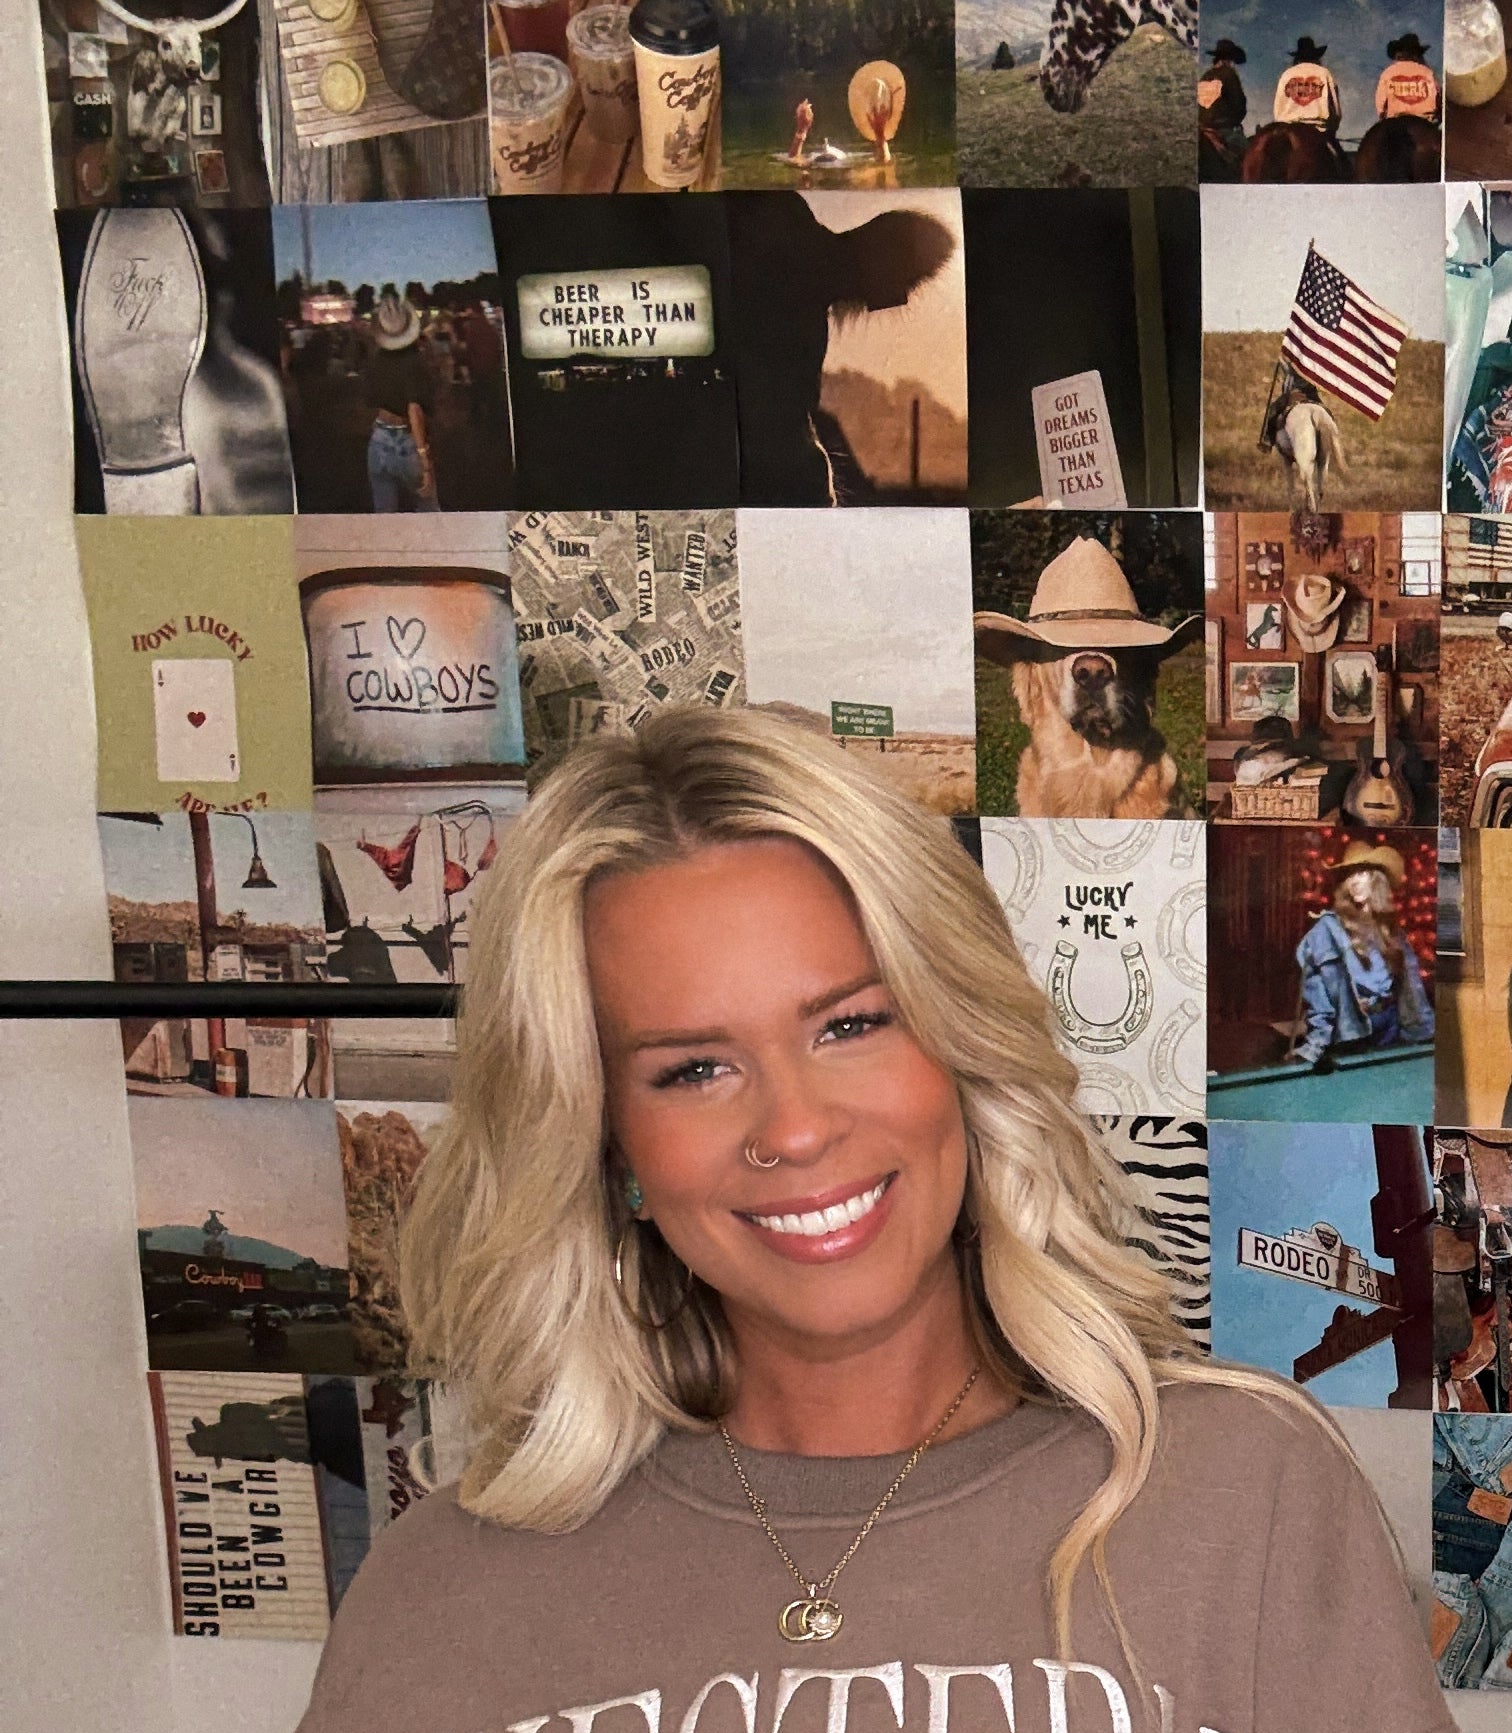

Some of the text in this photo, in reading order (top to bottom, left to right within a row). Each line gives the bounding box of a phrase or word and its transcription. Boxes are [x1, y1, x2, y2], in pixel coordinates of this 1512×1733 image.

[73, 91, 113, 106] CASH
[554, 281, 651, 304] BEER IS
[539, 302, 696, 327] CHEAPER THAN
[567, 327, 658, 348] THERAPY
[1054, 392, 1079, 412] GOT
[1044, 407, 1099, 435] DREAMS
[1049, 428, 1099, 454] BIGGER
[1058, 450, 1096, 473] THAN
[1058, 470, 1104, 496] TEXAS
[635, 511, 653, 619] WILD WEST
[683, 531, 706, 593] WANTED
[131, 615, 255, 662] HOW LUCKY
[341, 621, 373, 658] I
[640, 637, 696, 672] RODEO
[346, 663, 499, 707] COWBOYS
[1065, 881, 1134, 912] LUCKY
[1083, 914, 1118, 940] ME
[1253, 1236, 1330, 1280] RODEO
[1358, 1266, 1372, 1279] DR
[211, 1479, 255, 1610] BEEN A
